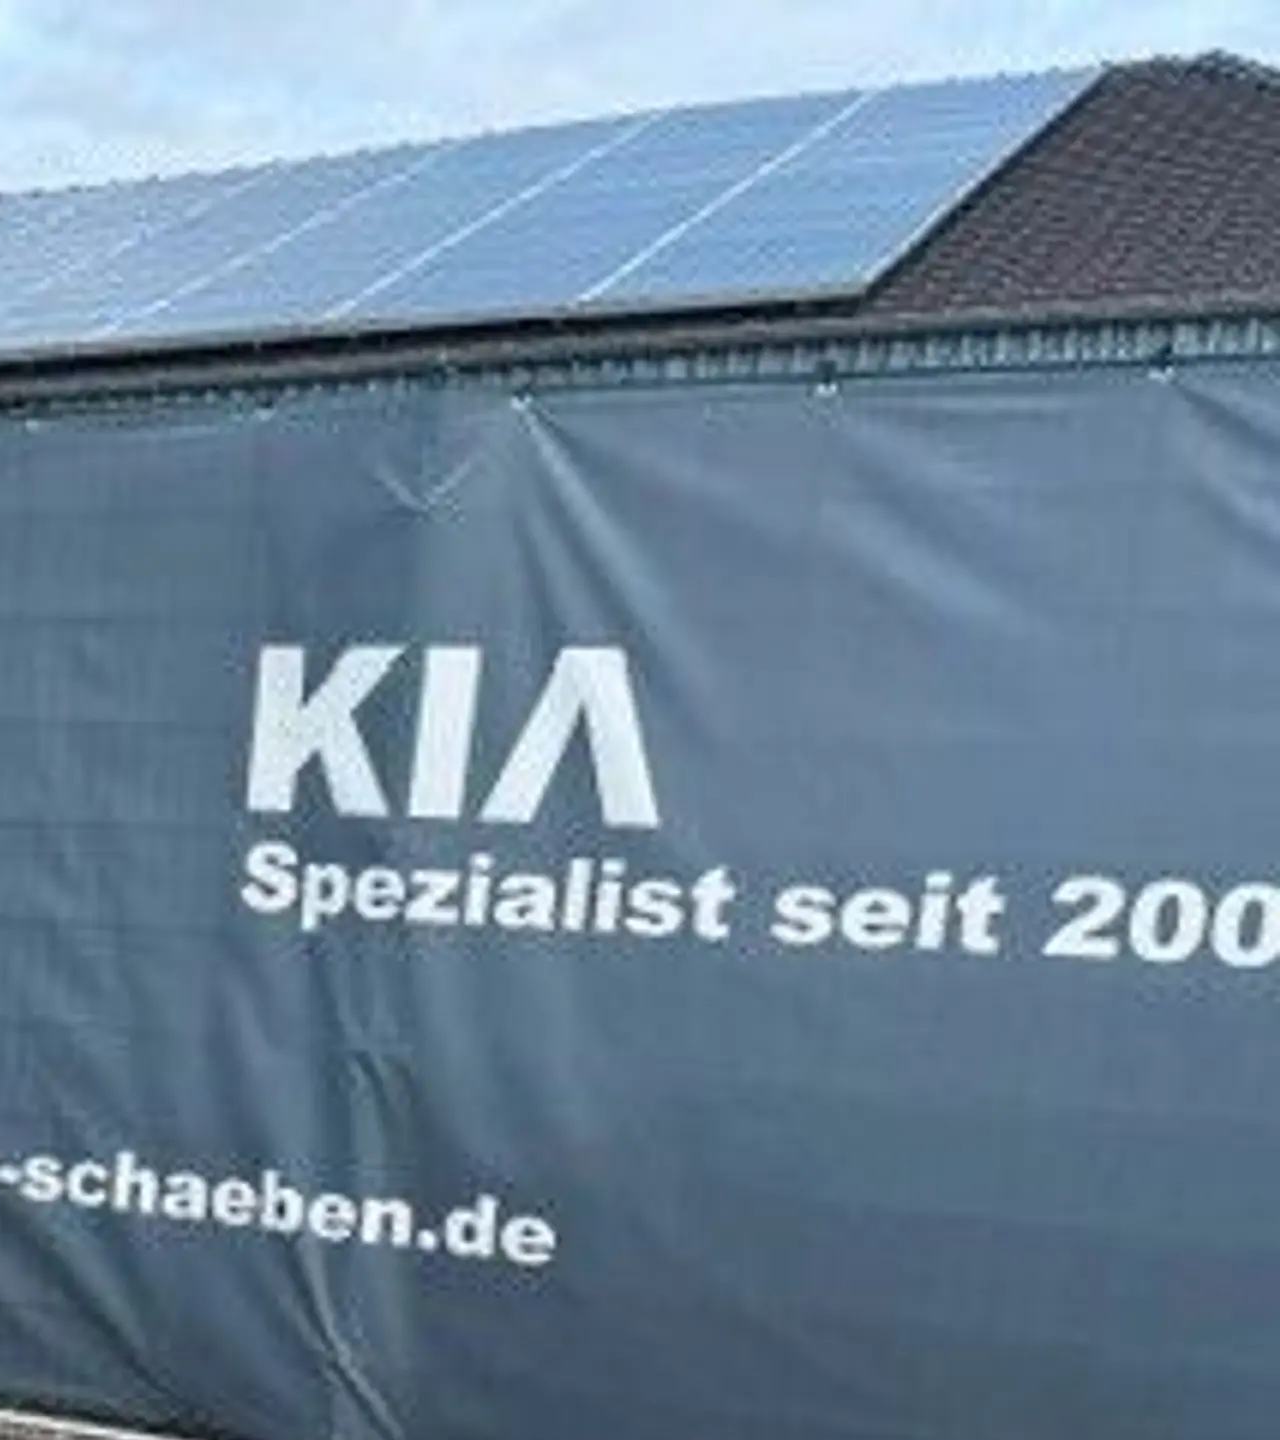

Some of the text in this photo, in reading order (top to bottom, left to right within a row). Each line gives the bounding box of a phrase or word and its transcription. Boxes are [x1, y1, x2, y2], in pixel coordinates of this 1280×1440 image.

[246, 645, 660, 829] KIA
[240, 841, 738, 941] Spezialist
[769, 870, 1007, 954] seit
